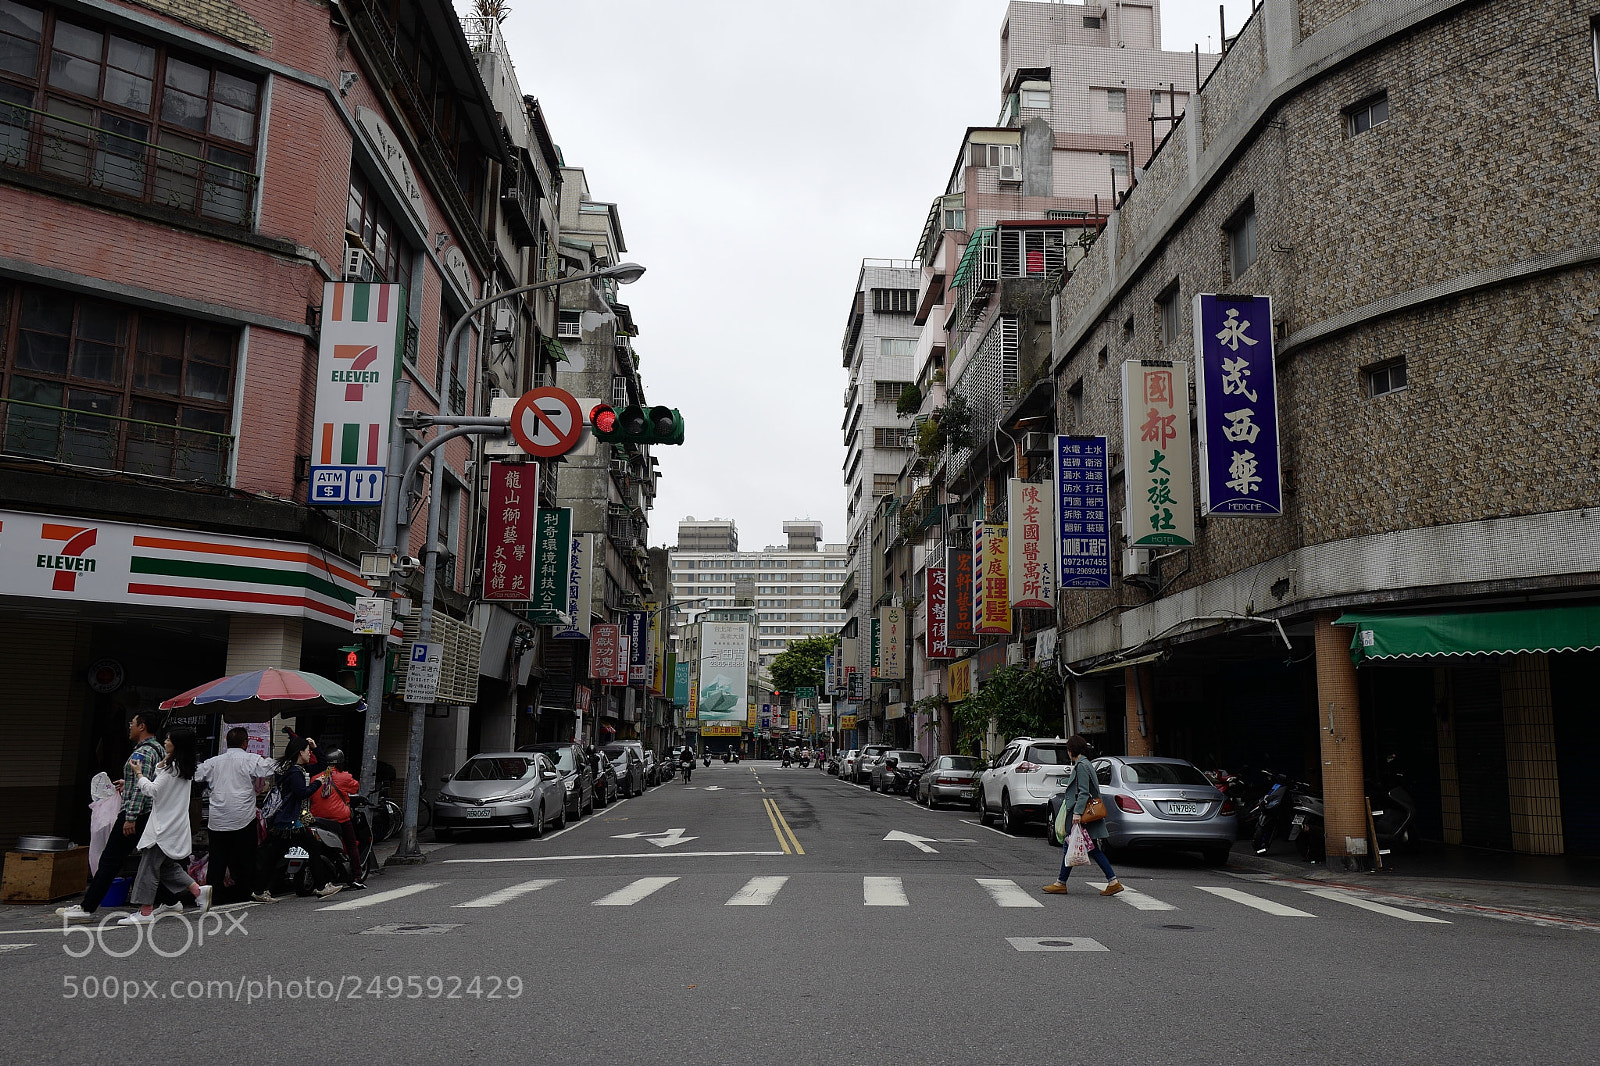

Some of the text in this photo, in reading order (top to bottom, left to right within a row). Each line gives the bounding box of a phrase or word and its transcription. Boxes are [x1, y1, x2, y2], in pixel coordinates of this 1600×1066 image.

[1215, 308, 1262, 495] 永茂西藥
[1062, 445, 1102, 455] 水電 土水
[1140, 370, 1177, 531] 國都大旅社
[1062, 458, 1081, 467] 磁磚
[318, 472, 343, 481] ATM
[1063, 471, 1103, 481] 漏水 油漆
[1063, 484, 1103, 493] 防水 打石
[502, 470, 522, 544] 龍山獅藝
[1063, 497, 1082, 506] 門窗
[1228, 502, 1261, 510] MEDICINE
[1064, 510, 1104, 520] 拆除 改建
[984, 527, 1008, 537] 平價
[1064, 523, 1082, 532] 翻新
[1021, 487, 1042, 600] 陳老國醫寓所
[1062, 538, 1106, 557] 加順工程行
[489, 545, 507, 590] 文物館
[540, 513, 559, 615] 利奇環境科技公司
[1063, 558, 1106, 566] 0972147455
[985, 538, 1008, 622] 家庭理髮
[1041, 563, 1051, 599] 天仁堂
[956, 553, 973, 630] 宏軒藝品
[631, 613, 642, 662] Panasonic
[414, 647, 424, 659] P
